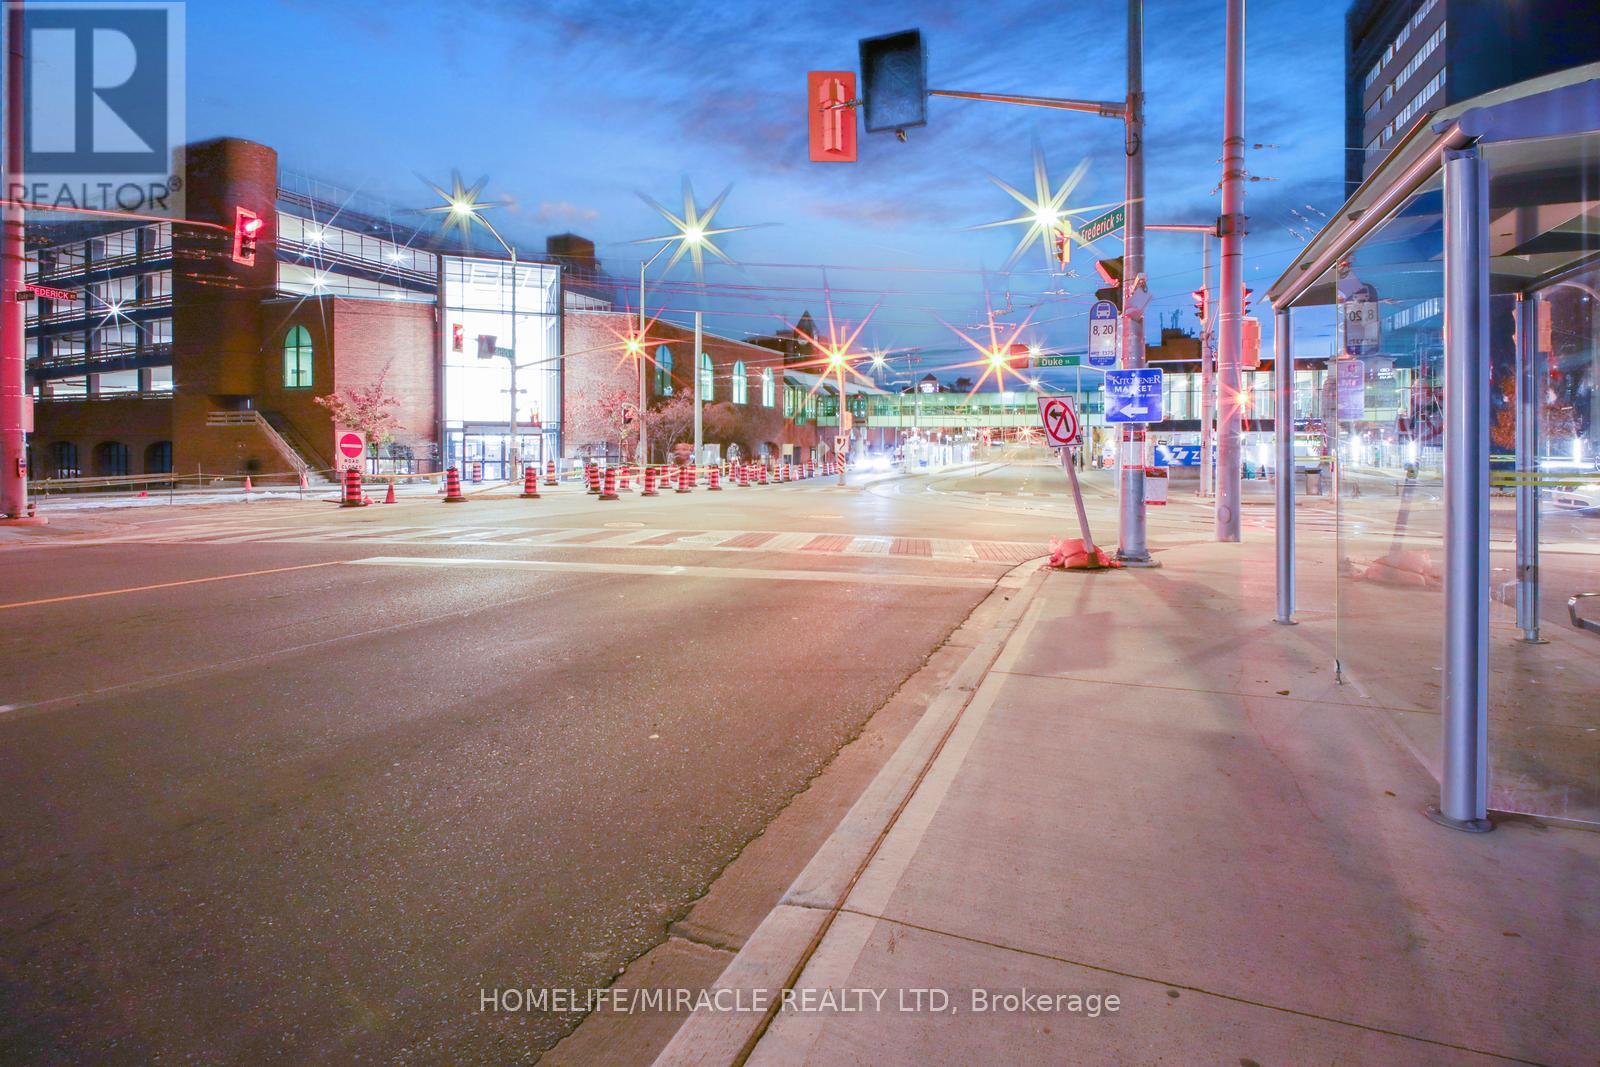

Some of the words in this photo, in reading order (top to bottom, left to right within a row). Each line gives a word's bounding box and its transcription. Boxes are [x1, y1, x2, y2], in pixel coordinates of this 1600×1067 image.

[1081, 214, 1115, 241] Frederick
[1093, 325, 1100, 336] 8,
[1102, 324, 1114, 335] 20
[1041, 358, 1064, 366] Duke
[1114, 384, 1153, 393] MAKET
